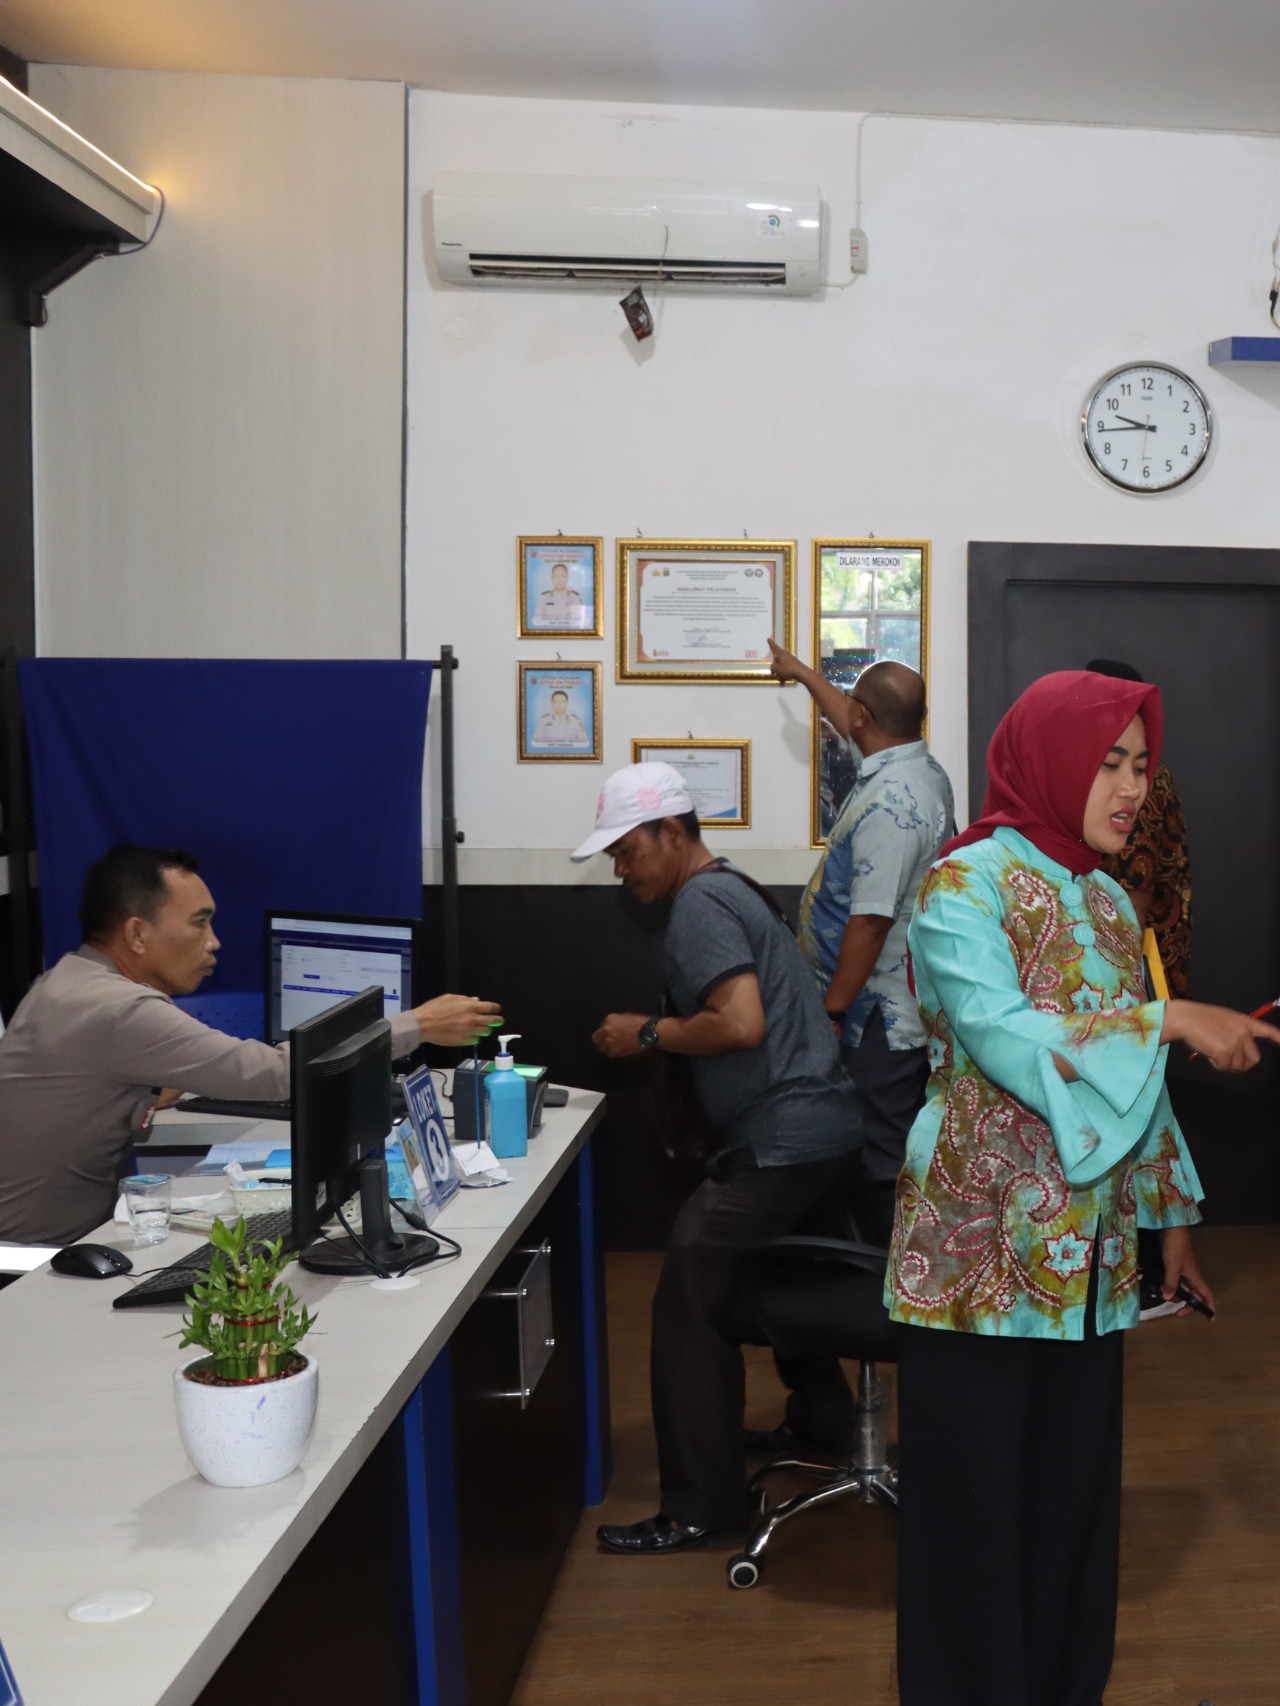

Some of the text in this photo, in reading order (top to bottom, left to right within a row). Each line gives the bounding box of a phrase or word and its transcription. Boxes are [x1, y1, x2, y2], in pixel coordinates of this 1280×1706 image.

[1120, 384, 1132, 396] 11
[1141, 378, 1154, 390] 12
[1167, 385, 1173, 397] 1
[1106, 398, 1119, 411] 10
[1182, 401, 1190, 413] 2
[1097, 421, 1105, 432] 9
[1189, 423, 1196, 435] 3
[1104, 442, 1111, 455] 8
[1181, 445, 1188, 457] 4
[1121, 459, 1128, 471] 7
[1165, 460, 1172, 472] 5
[1142, 466, 1150, 478] 6
[839, 556, 901, 567] DILARANG MEROKOK
[412, 1084, 437, 1124] LOKET
